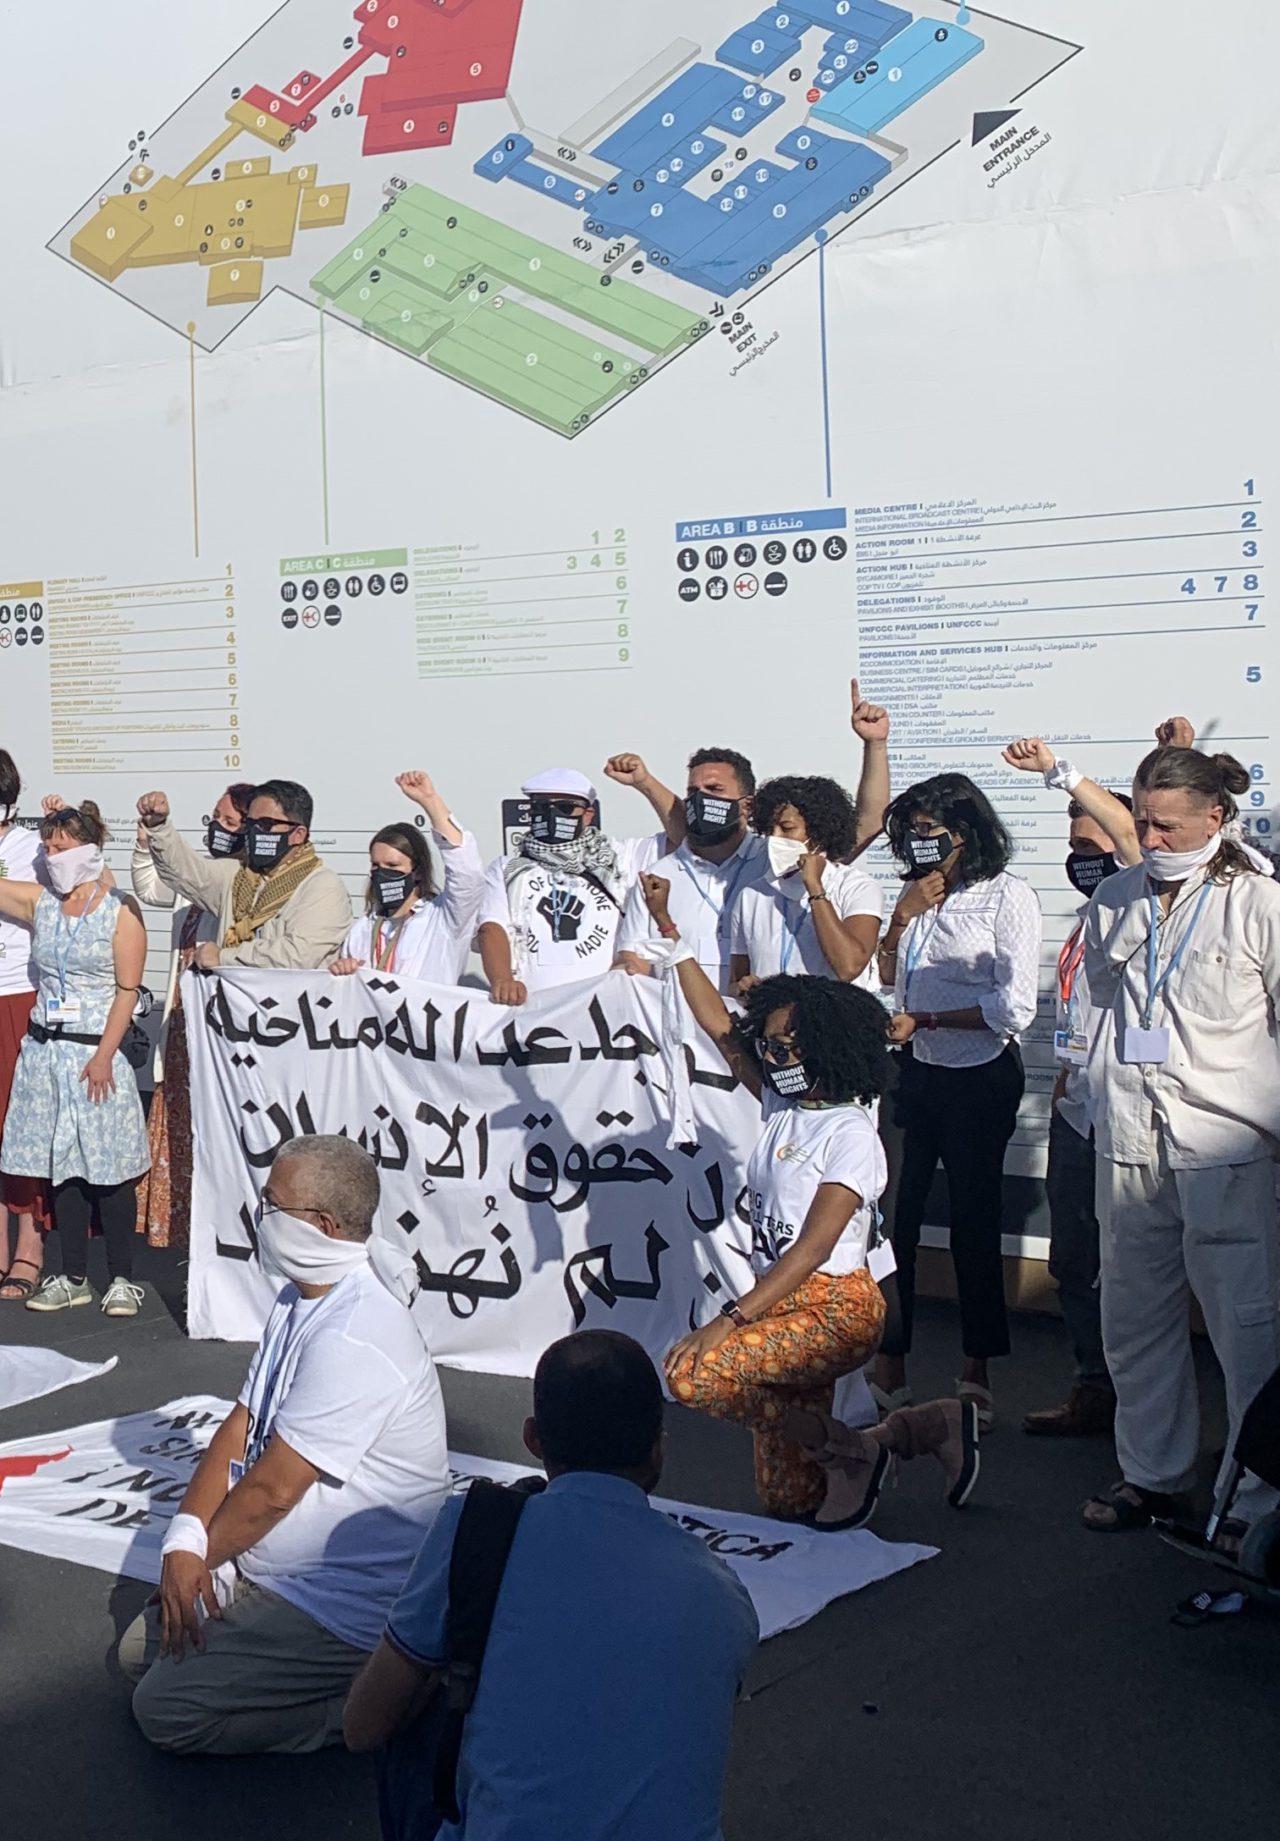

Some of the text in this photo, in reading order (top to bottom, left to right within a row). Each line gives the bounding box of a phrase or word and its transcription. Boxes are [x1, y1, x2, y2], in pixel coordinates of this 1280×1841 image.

[845, 41, 858, 50] 22
[835, 58, 846, 67] 21
[989, 126, 1018, 151] MAIN
[983, 126, 1040, 172] ENTRANCE
[1024, 132, 1052, 160] المدخل
[736, 187, 746, 196] 11
[721, 200, 733, 209] 12
[728, 322, 753, 344] MAIN
[736, 332, 757, 353] EXIT
[1244, 480, 1255, 496] 1
[854, 504, 917, 515] MEDIA CENTRE
[760, 517, 804, 531] منطقة
[1241, 511, 1257, 528] 2
[682, 521, 735, 538] AREA B
[746, 520, 757, 532] B
[592, 532, 599, 544] 1
[614, 529, 625, 542] 2
[856, 538, 915, 549] ACTION ROOM
[1242, 541, 1257, 557] 3
[332, 558, 341, 568] C
[567, 556, 577, 569] 3
[590, 554, 602, 567] 4
[615, 552, 626, 566] 5
[226, 564, 232, 575] 1
[284, 559, 324, 573] AREA C
[856, 565, 887, 574] ACTION
[616, 577, 626, 590] 6
[1181, 574, 1259, 594] 4 7 8
[225, 584, 234, 596] 2
[680, 586, 698, 594] ATM
[617, 600, 627, 613] 7
[857, 596, 915, 606] DELEGATIONS
[226, 606, 234, 618] 3
[1245, 604, 1258, 620] 7
[859, 622, 939, 634] UNFCCC PAVILIONS
[946, 620, 982, 628] UNFCCC
[617, 624, 628, 638] 8
[226, 632, 235, 644] 4
[618, 649, 629, 662] 9
[859, 644, 1002, 659] INFORMATION AND SERVICES HUB
[227, 653, 236, 664] 5
[228, 674, 237, 686] 6
[1246, 667, 1261, 683] 5
[229, 694, 237, 705] 7
[229, 715, 238, 726] 8
[230, 735, 239, 747] 9
[224, 755, 240, 767] 10
[1250, 764, 1264, 780] 6
[702, 798, 732, 810] WITHOUT
[1251, 791, 1264, 807] 9
[704, 806, 728, 816] HUMAN
[702, 813, 726, 825] RIGHTS
[911, 840, 939, 848] WITHOUT
[914, 848, 939, 856] HUMAN
[915, 854, 942, 864] RIGHTS
[1072, 859, 1104, 870] WITHOUT
[1075, 868, 1103, 878] HUMAN
[528, 877, 545, 892] OF
[575, 924, 609, 958] NADIE
[770, 1065, 805, 1081] WITHOUT
[775, 1074, 805, 1088] HUMAN
[780, 1082, 809, 1095] RIGHTS
[508, 1109, 674, 1212] حقوق
[564, 1221, 671, 1328] لم
